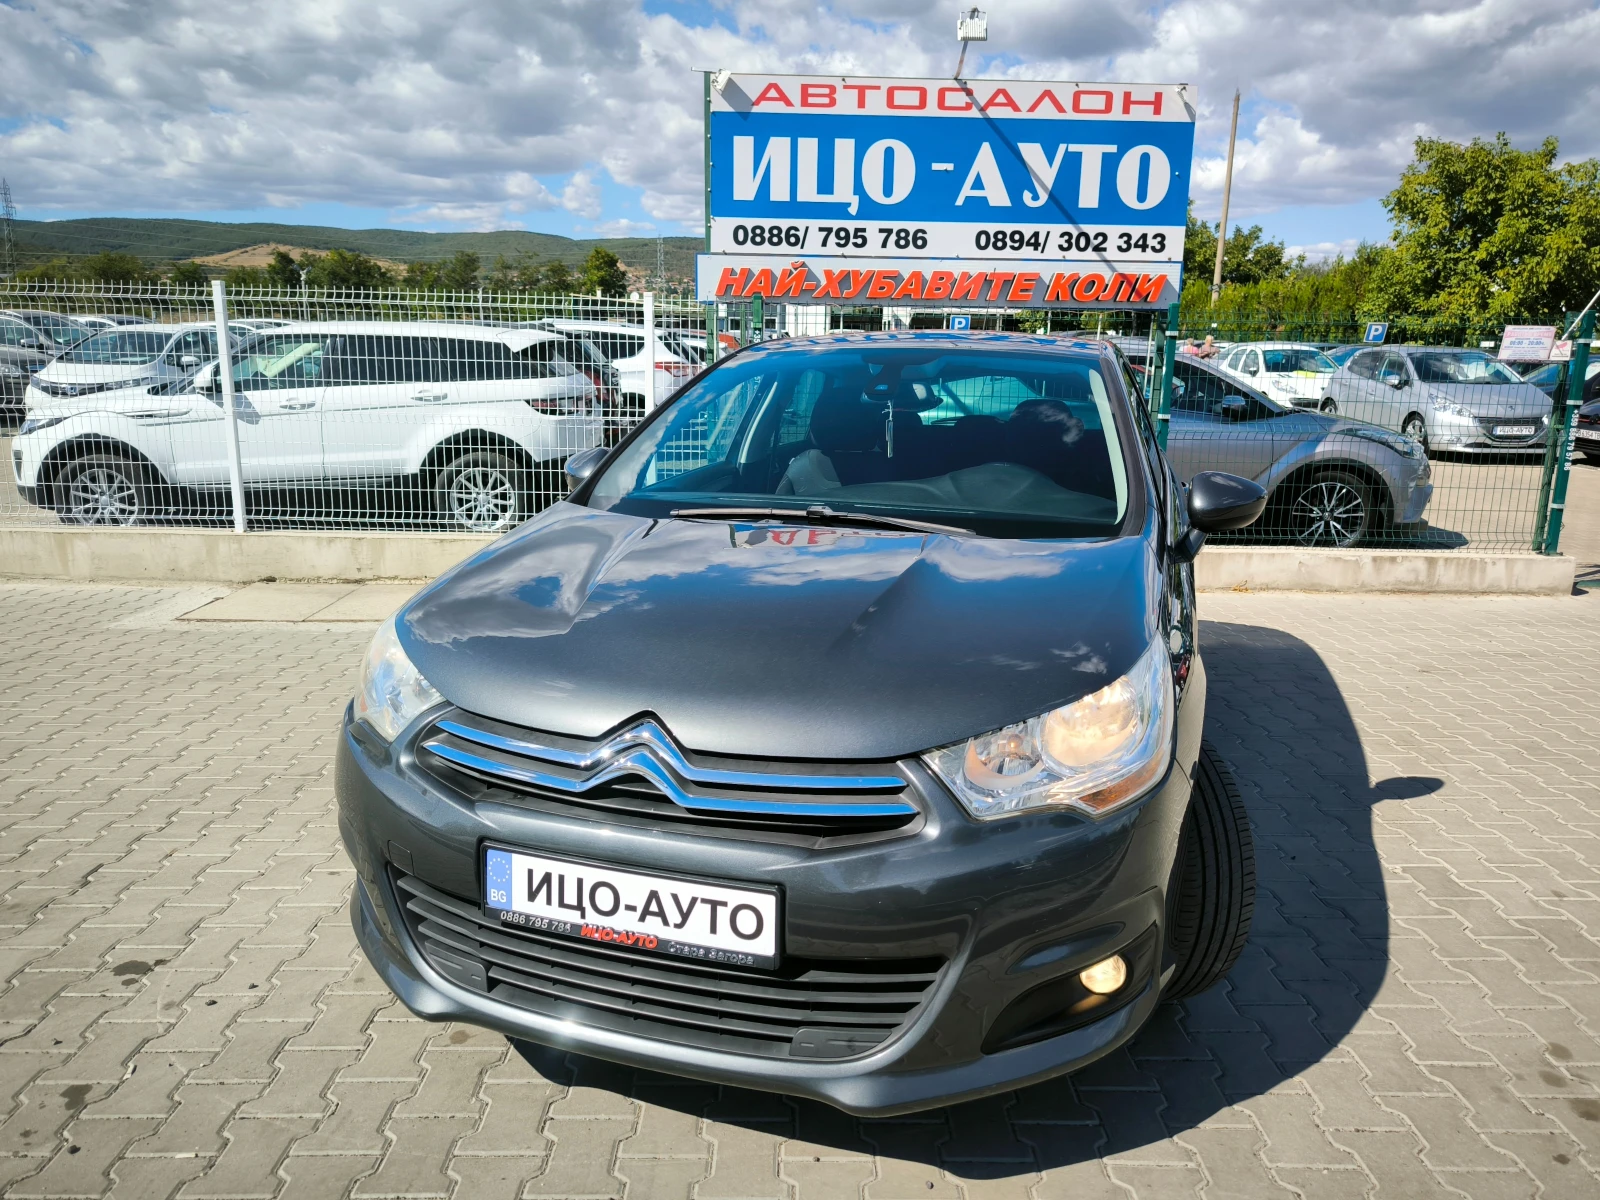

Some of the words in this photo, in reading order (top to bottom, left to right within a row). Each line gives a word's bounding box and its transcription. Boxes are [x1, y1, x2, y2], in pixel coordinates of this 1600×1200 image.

[753, 82, 1164, 117] АВТОСАЛОН
[732, 224, 809, 250] 0886/
[818, 226, 868, 248] 795
[878, 228, 928, 250] 786
[975, 230, 1051, 254] 0894/
[1057, 231, 1108, 253] 302
[1116, 232, 1166, 254] 343
[715, 261, 1041, 302] НАЙ-ХУБАВИТЕ
[1045, 271, 1168, 303] КОЛИ
[954, 318, 966, 329] P
[1368, 325, 1383, 340] P
[490, 888, 507, 903] BG
[527, 868, 764, 940] ИЦО-АУТО
[500, 910, 526, 925] 0886
[528, 916, 549, 929] 795
[580, 923, 659, 950] ИЦО-АУТО
[667, 941, 706, 958] Стара
[708, 948, 755, 966] Загора
